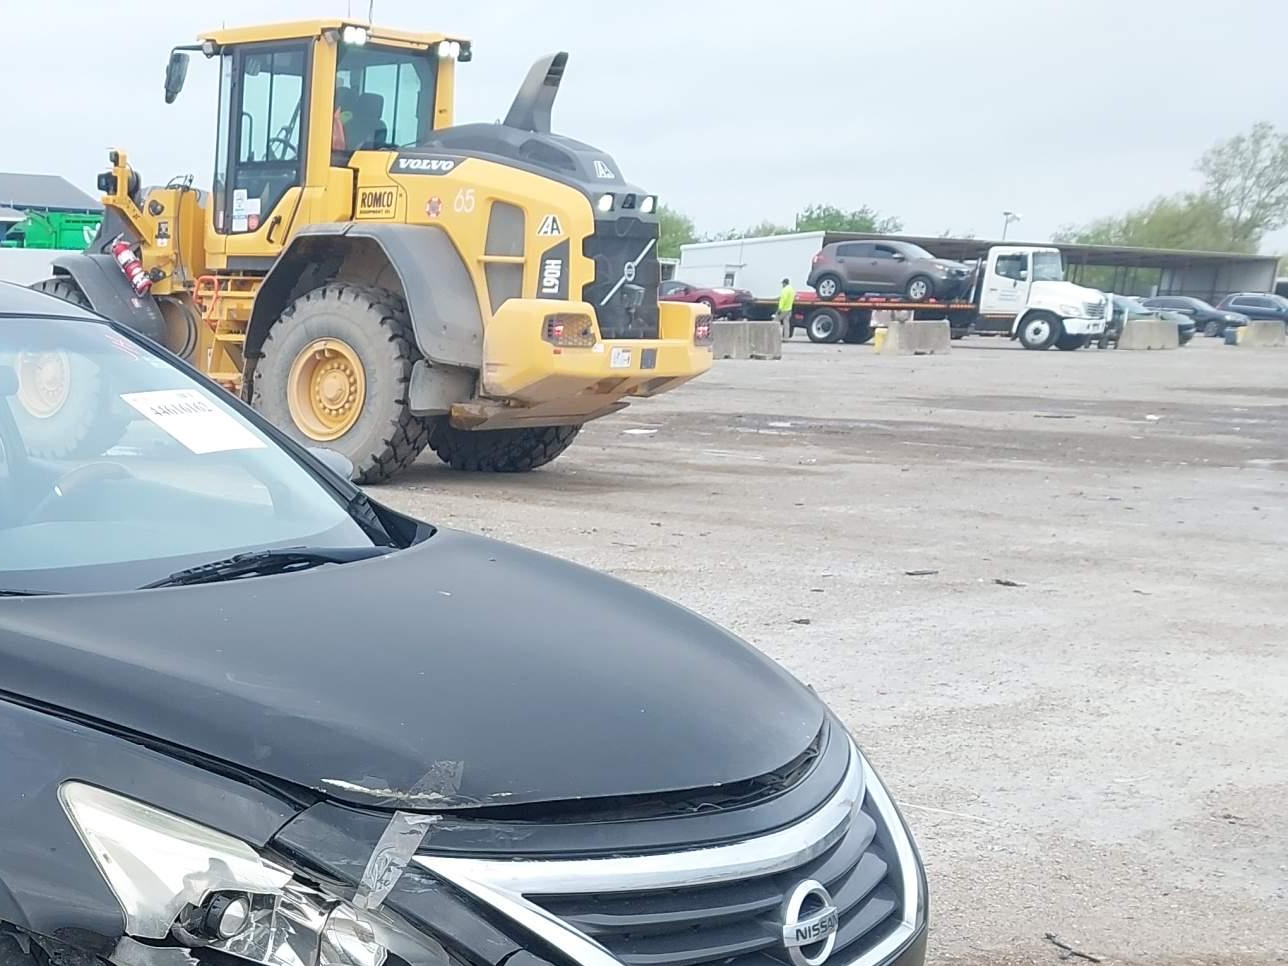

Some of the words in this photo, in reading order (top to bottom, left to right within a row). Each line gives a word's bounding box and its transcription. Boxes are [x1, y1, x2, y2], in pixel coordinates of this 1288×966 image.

[398, 158, 454, 171] VOLVO
[360, 191, 393, 208] ROMCO
[454, 189, 475, 213] 65
[541, 259, 563, 294] L90H
[795, 912, 838, 941] NISSAN
